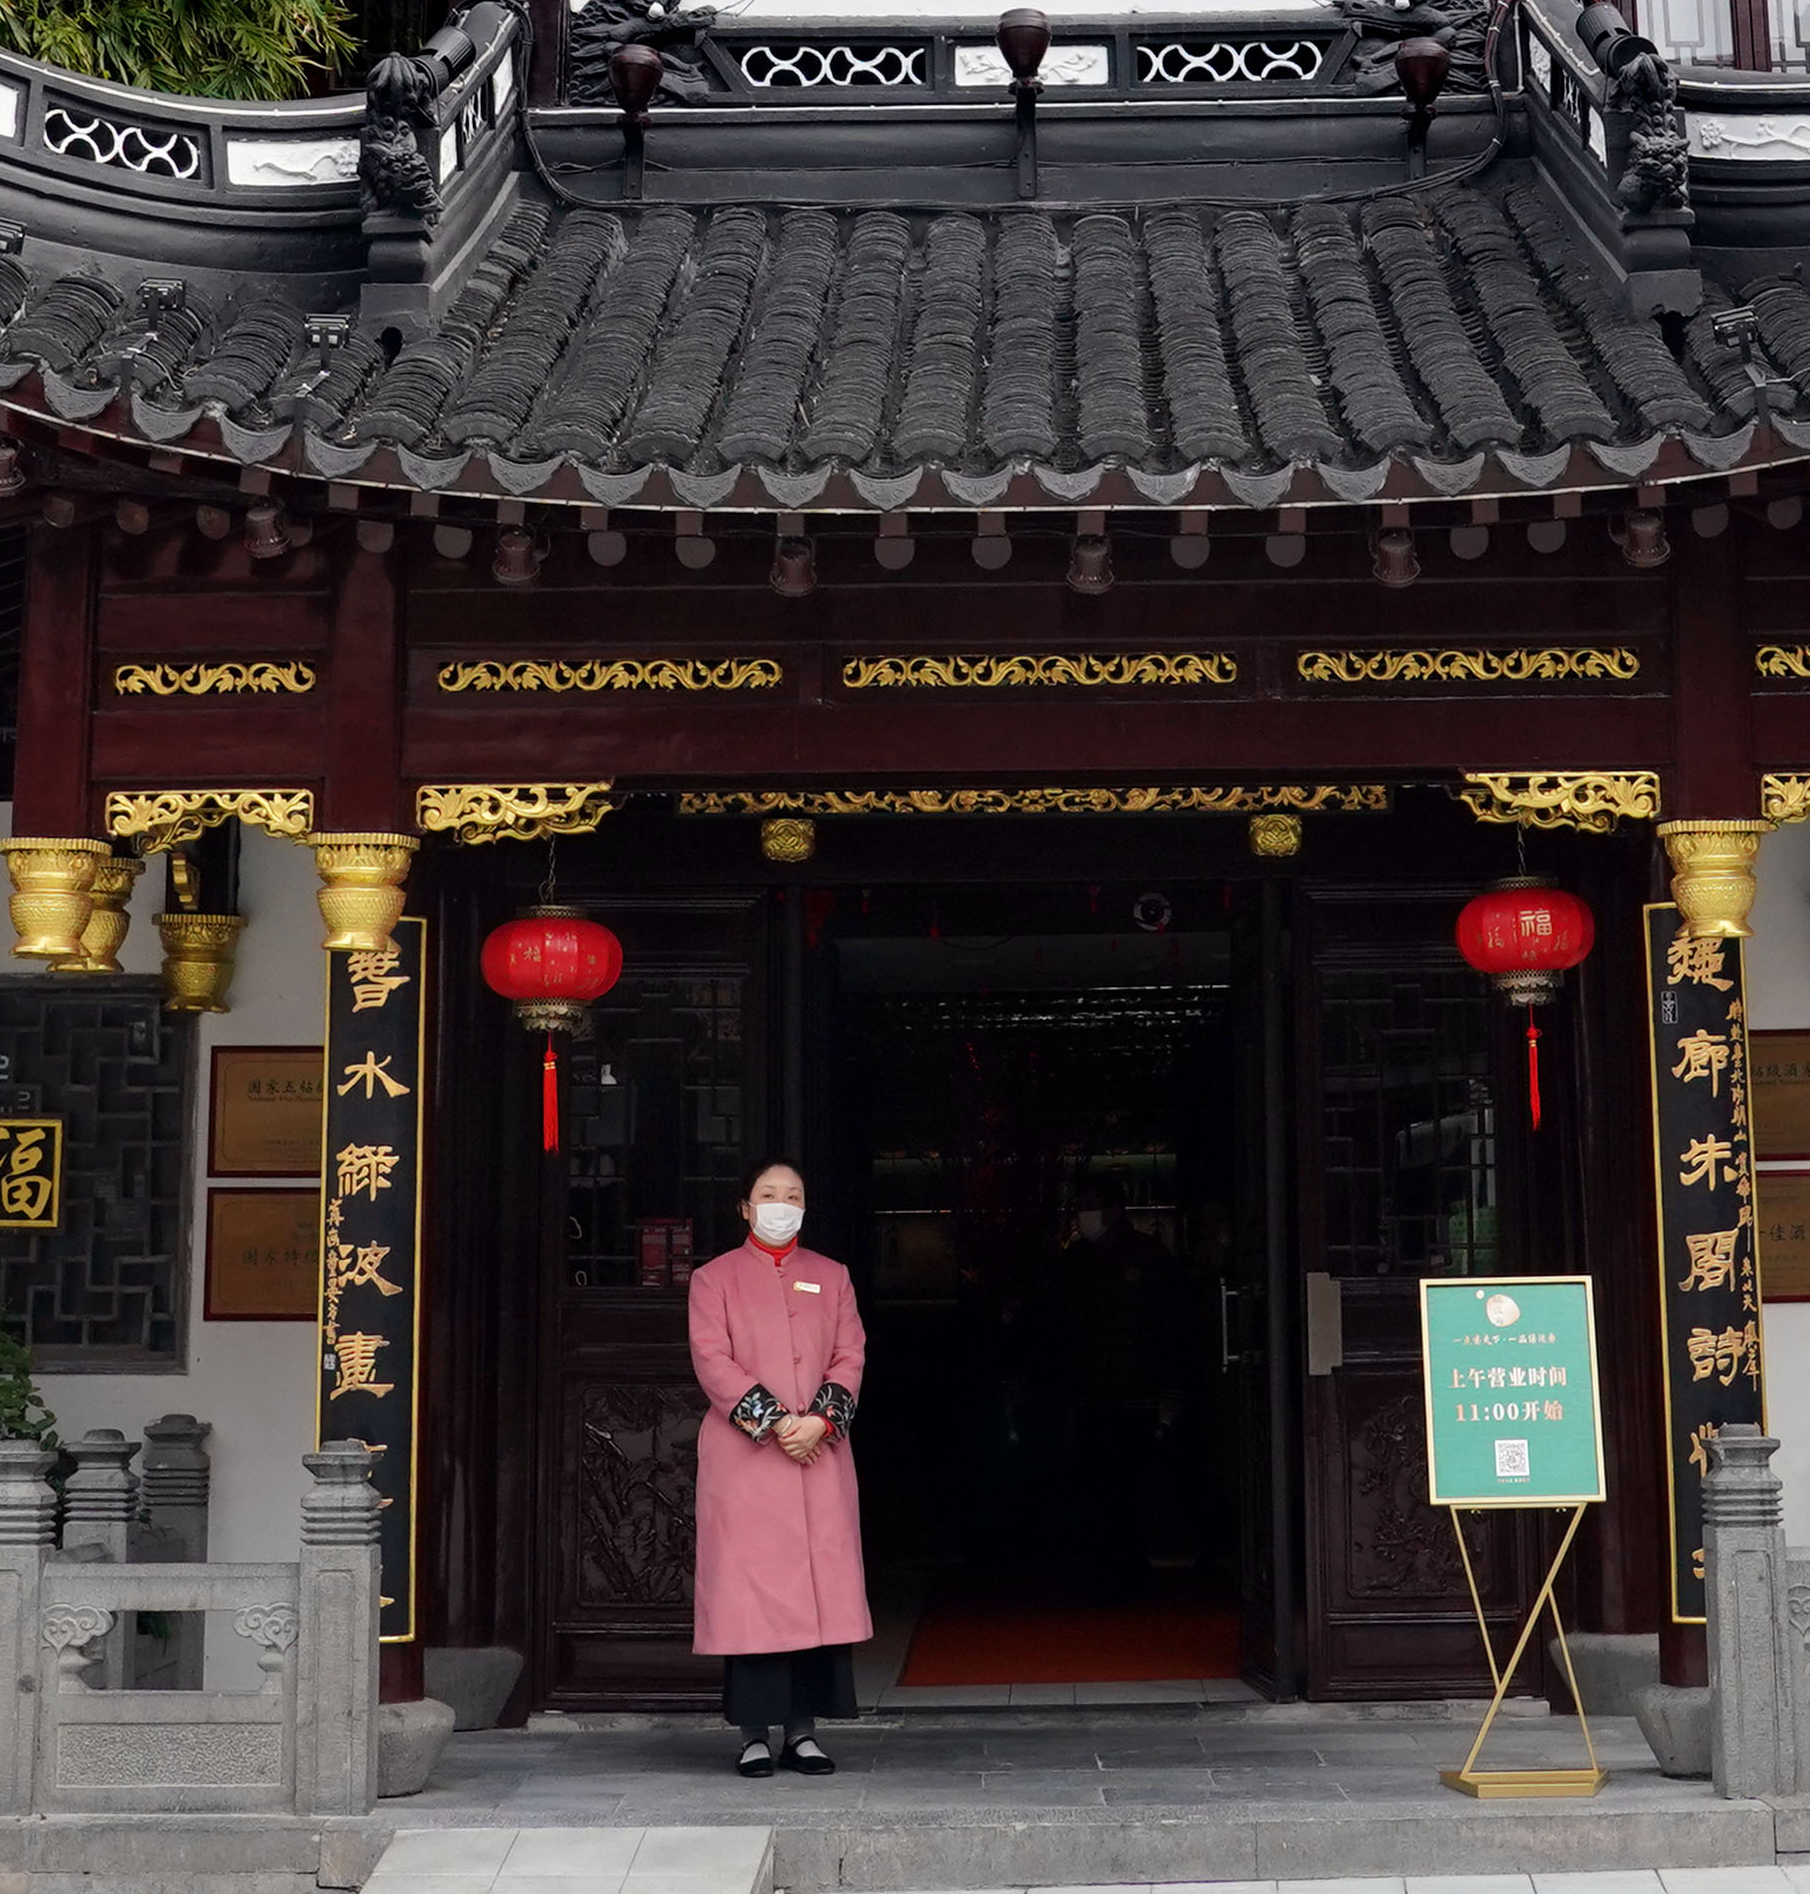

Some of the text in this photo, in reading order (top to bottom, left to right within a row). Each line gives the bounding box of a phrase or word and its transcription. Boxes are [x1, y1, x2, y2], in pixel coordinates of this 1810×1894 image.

[1519, 908, 1552, 937] 福
[1449, 1366, 1567, 1388] 上午营业时间
[1455, 1399, 1563, 1422] 11:00开始
